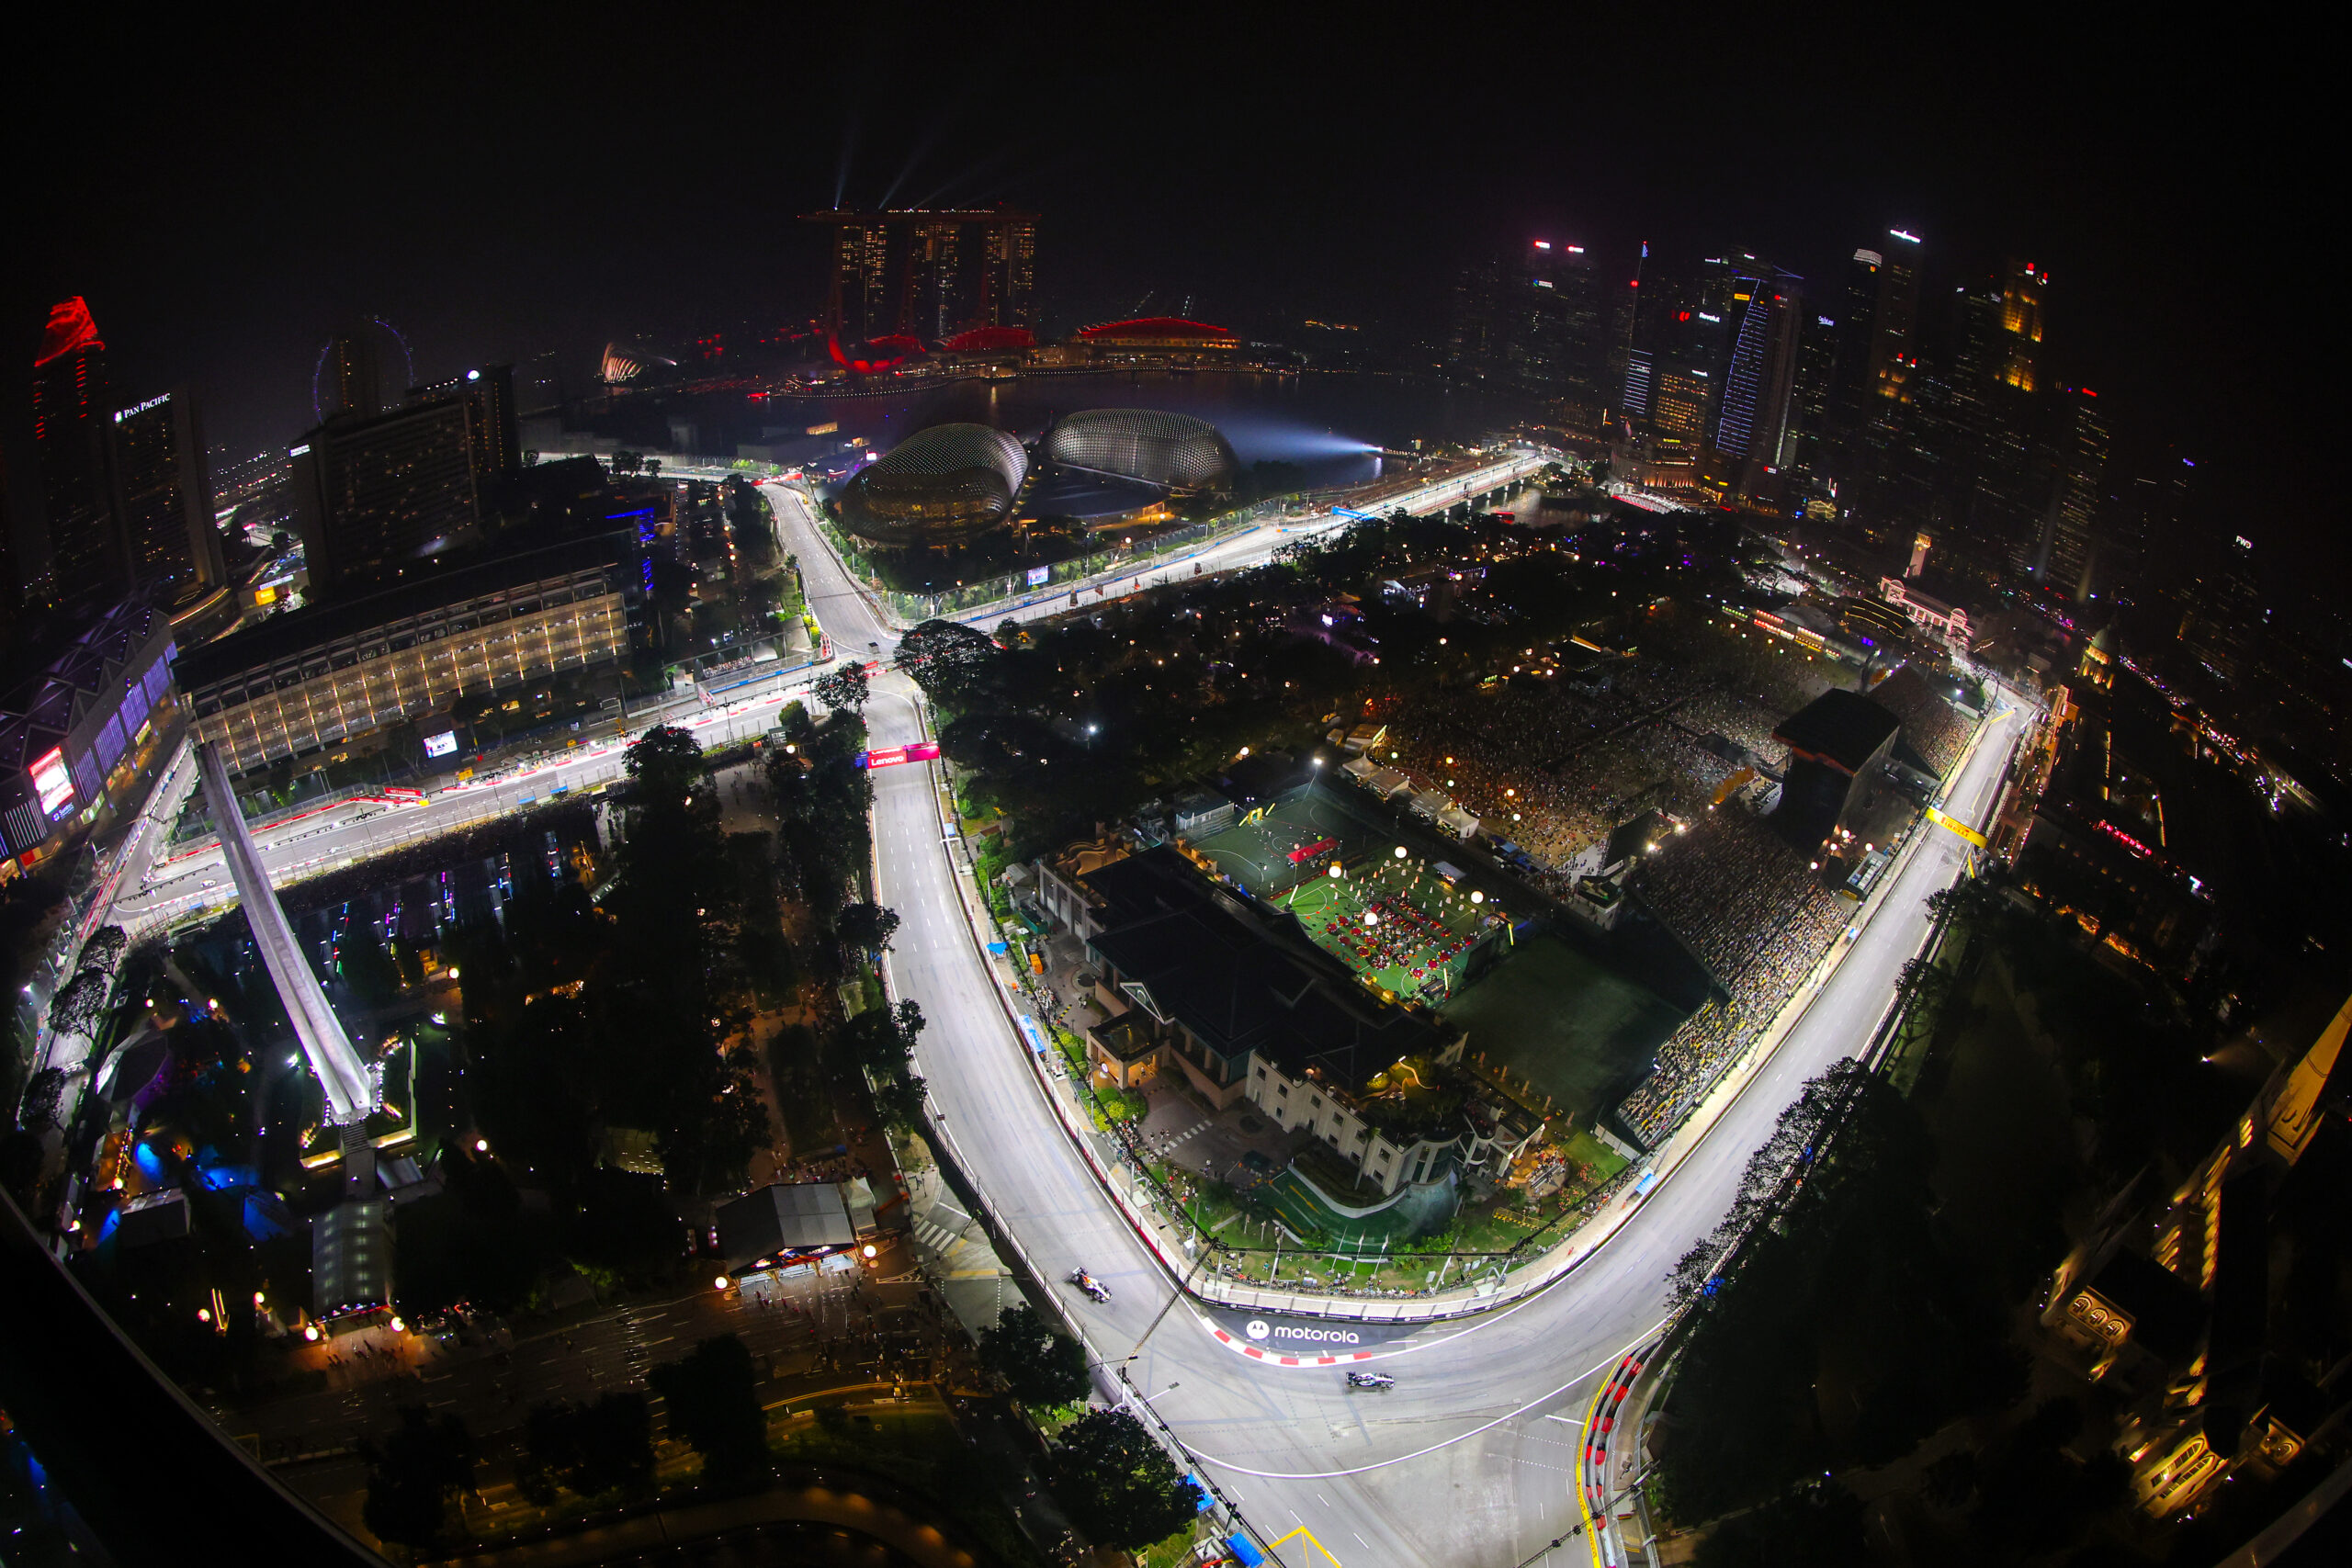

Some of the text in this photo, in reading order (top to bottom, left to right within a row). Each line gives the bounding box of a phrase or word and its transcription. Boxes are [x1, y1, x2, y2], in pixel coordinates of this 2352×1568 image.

[123, 392, 171, 419] PAN PACIFIC
[2235, 535, 2253, 549] FWD
[870, 755, 904, 766] Lenovo
[1274, 1325, 1360, 1344] motorola
